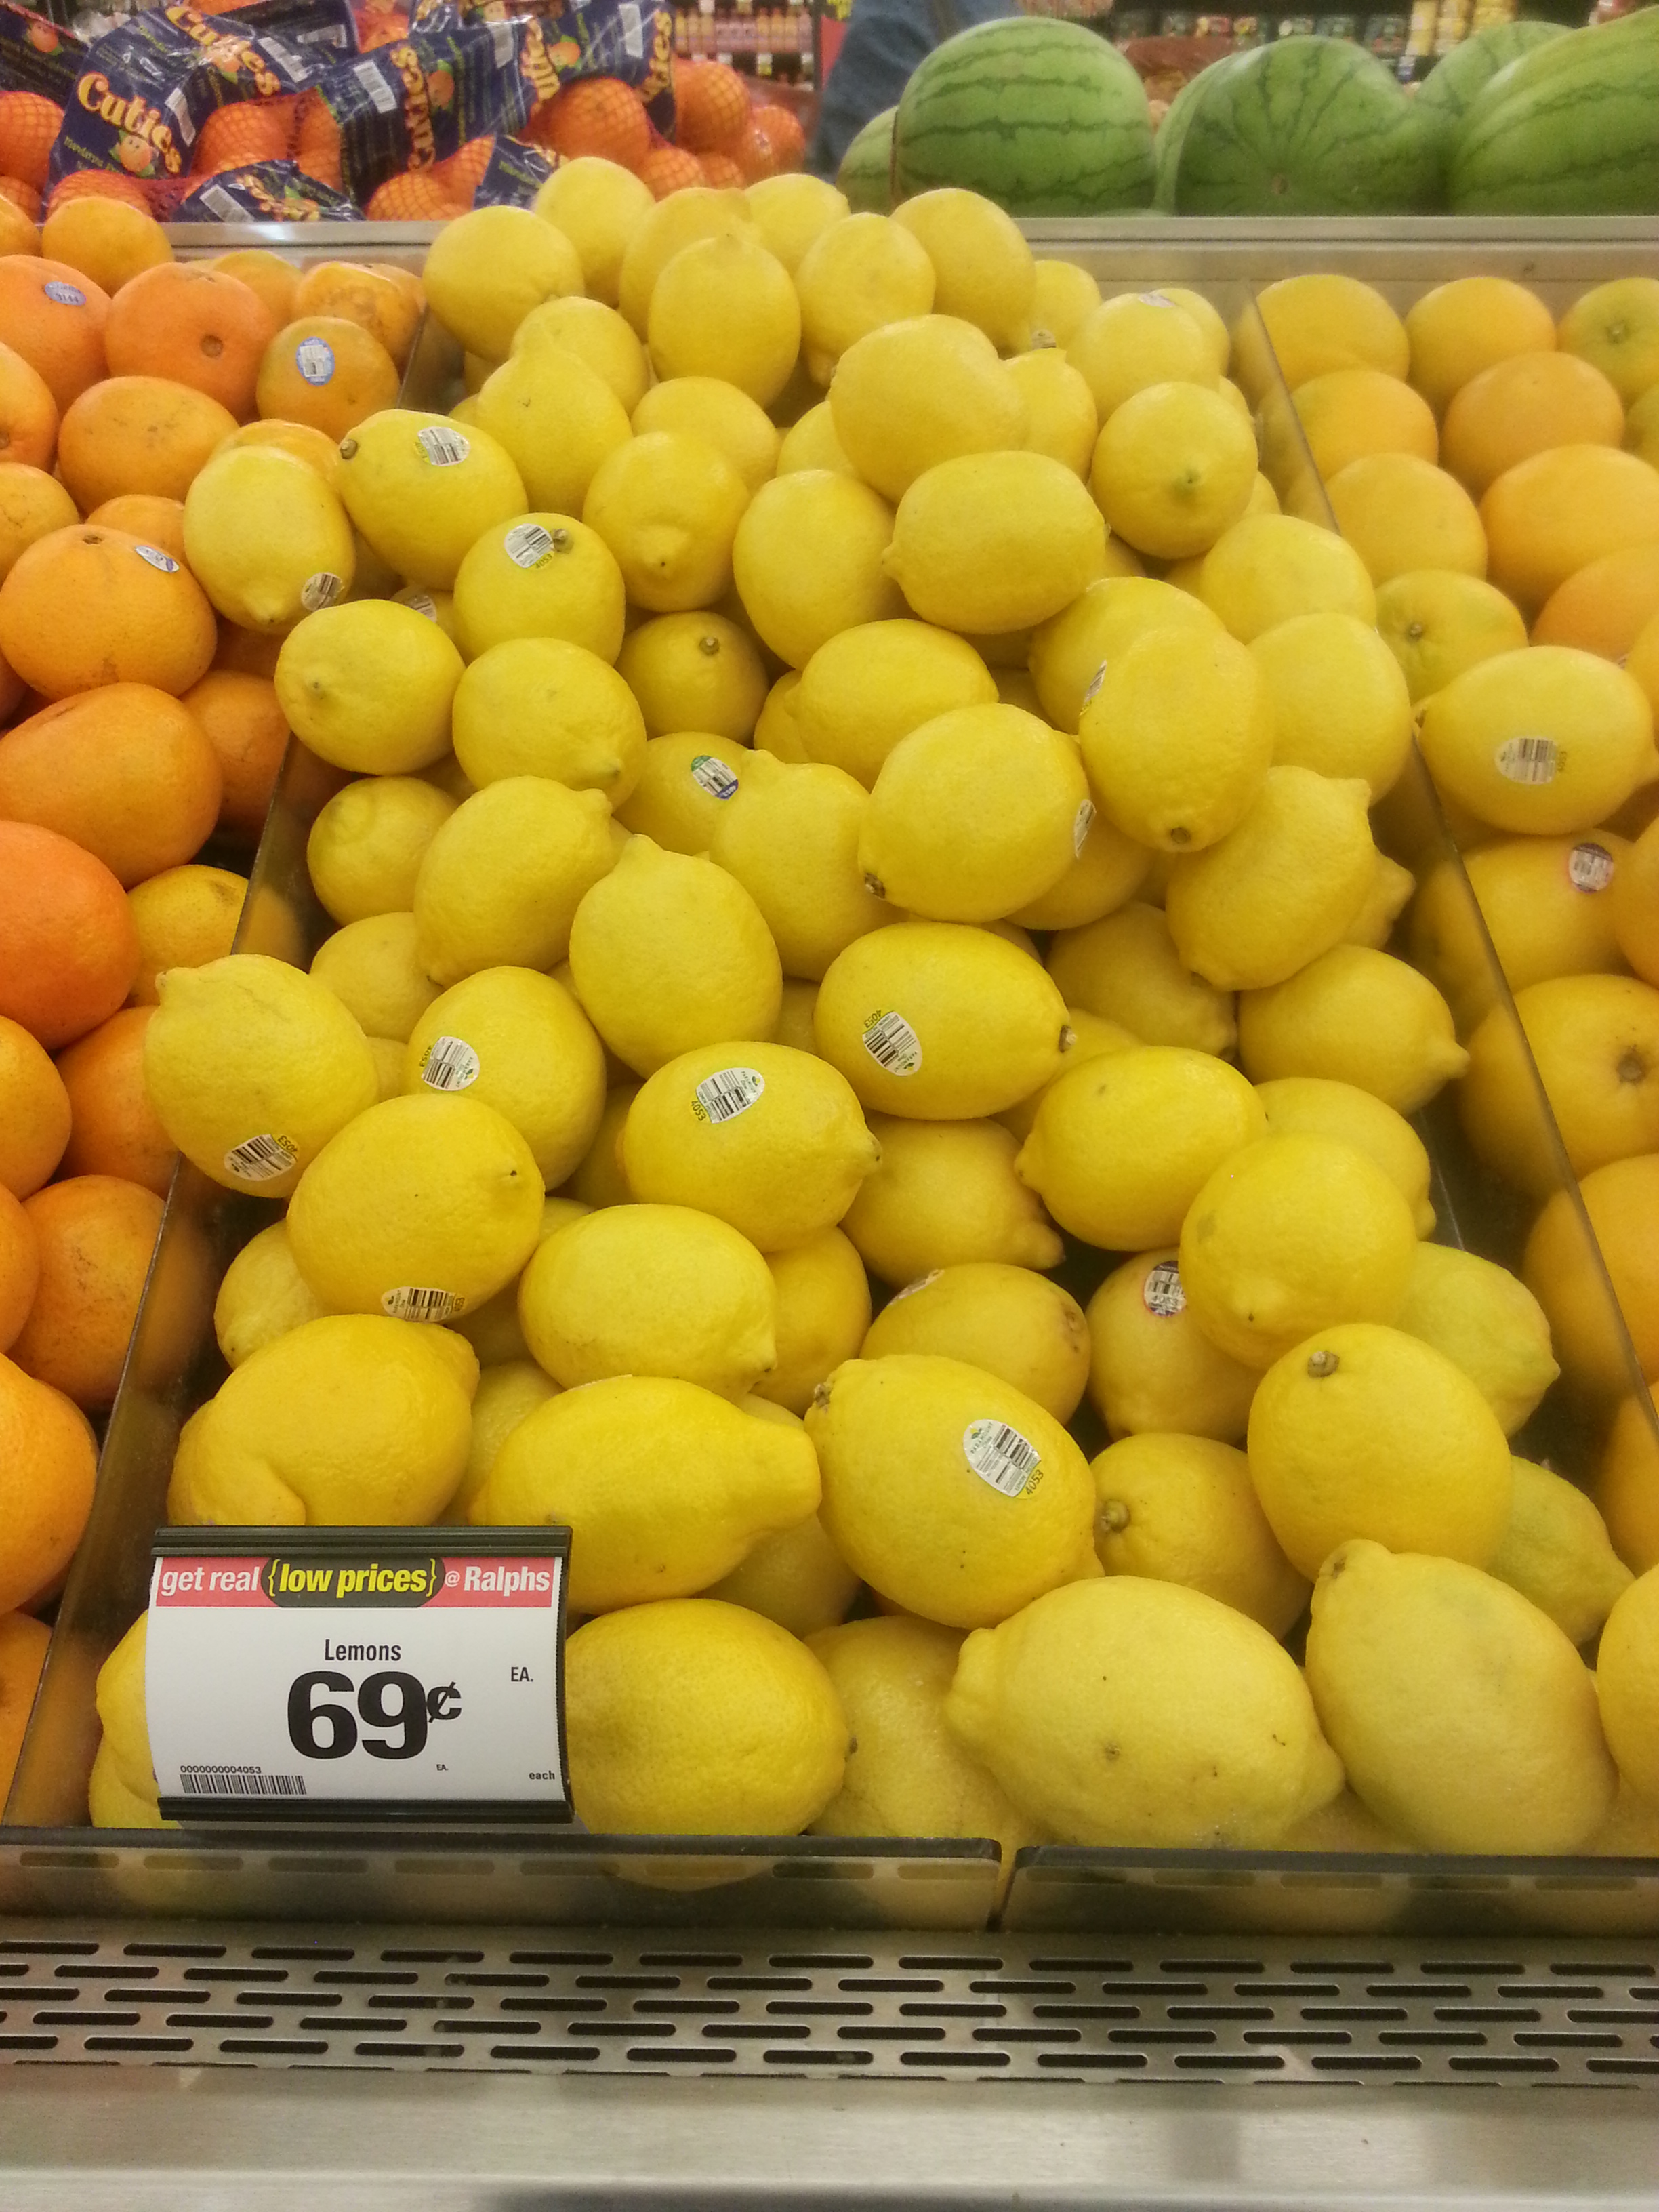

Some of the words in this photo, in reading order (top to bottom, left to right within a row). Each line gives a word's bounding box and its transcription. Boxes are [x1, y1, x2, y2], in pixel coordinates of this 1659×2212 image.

[77, 70, 182, 174] Cuties
[536, 554, 552, 569] 4053
[864, 1009, 882, 1028] 4053
[419, 1045, 432, 1068] 4053
[691, 1100, 707, 1122] 4053
[277, 1135, 298, 1153] 4053
[1025, 1469, 1044, 1496] 4053
[161, 1566, 205, 1597] get
[209, 1566, 260, 1591] real
[444, 1570, 461, 1587] @
[464, 1566, 550, 1597] Ralphs
[324, 1639, 402, 1662] Lemons
[510, 1666, 535, 1683] EA.
[180, 1765, 262, 1774] 0000000004053
[529, 1770, 556, 1780] each
